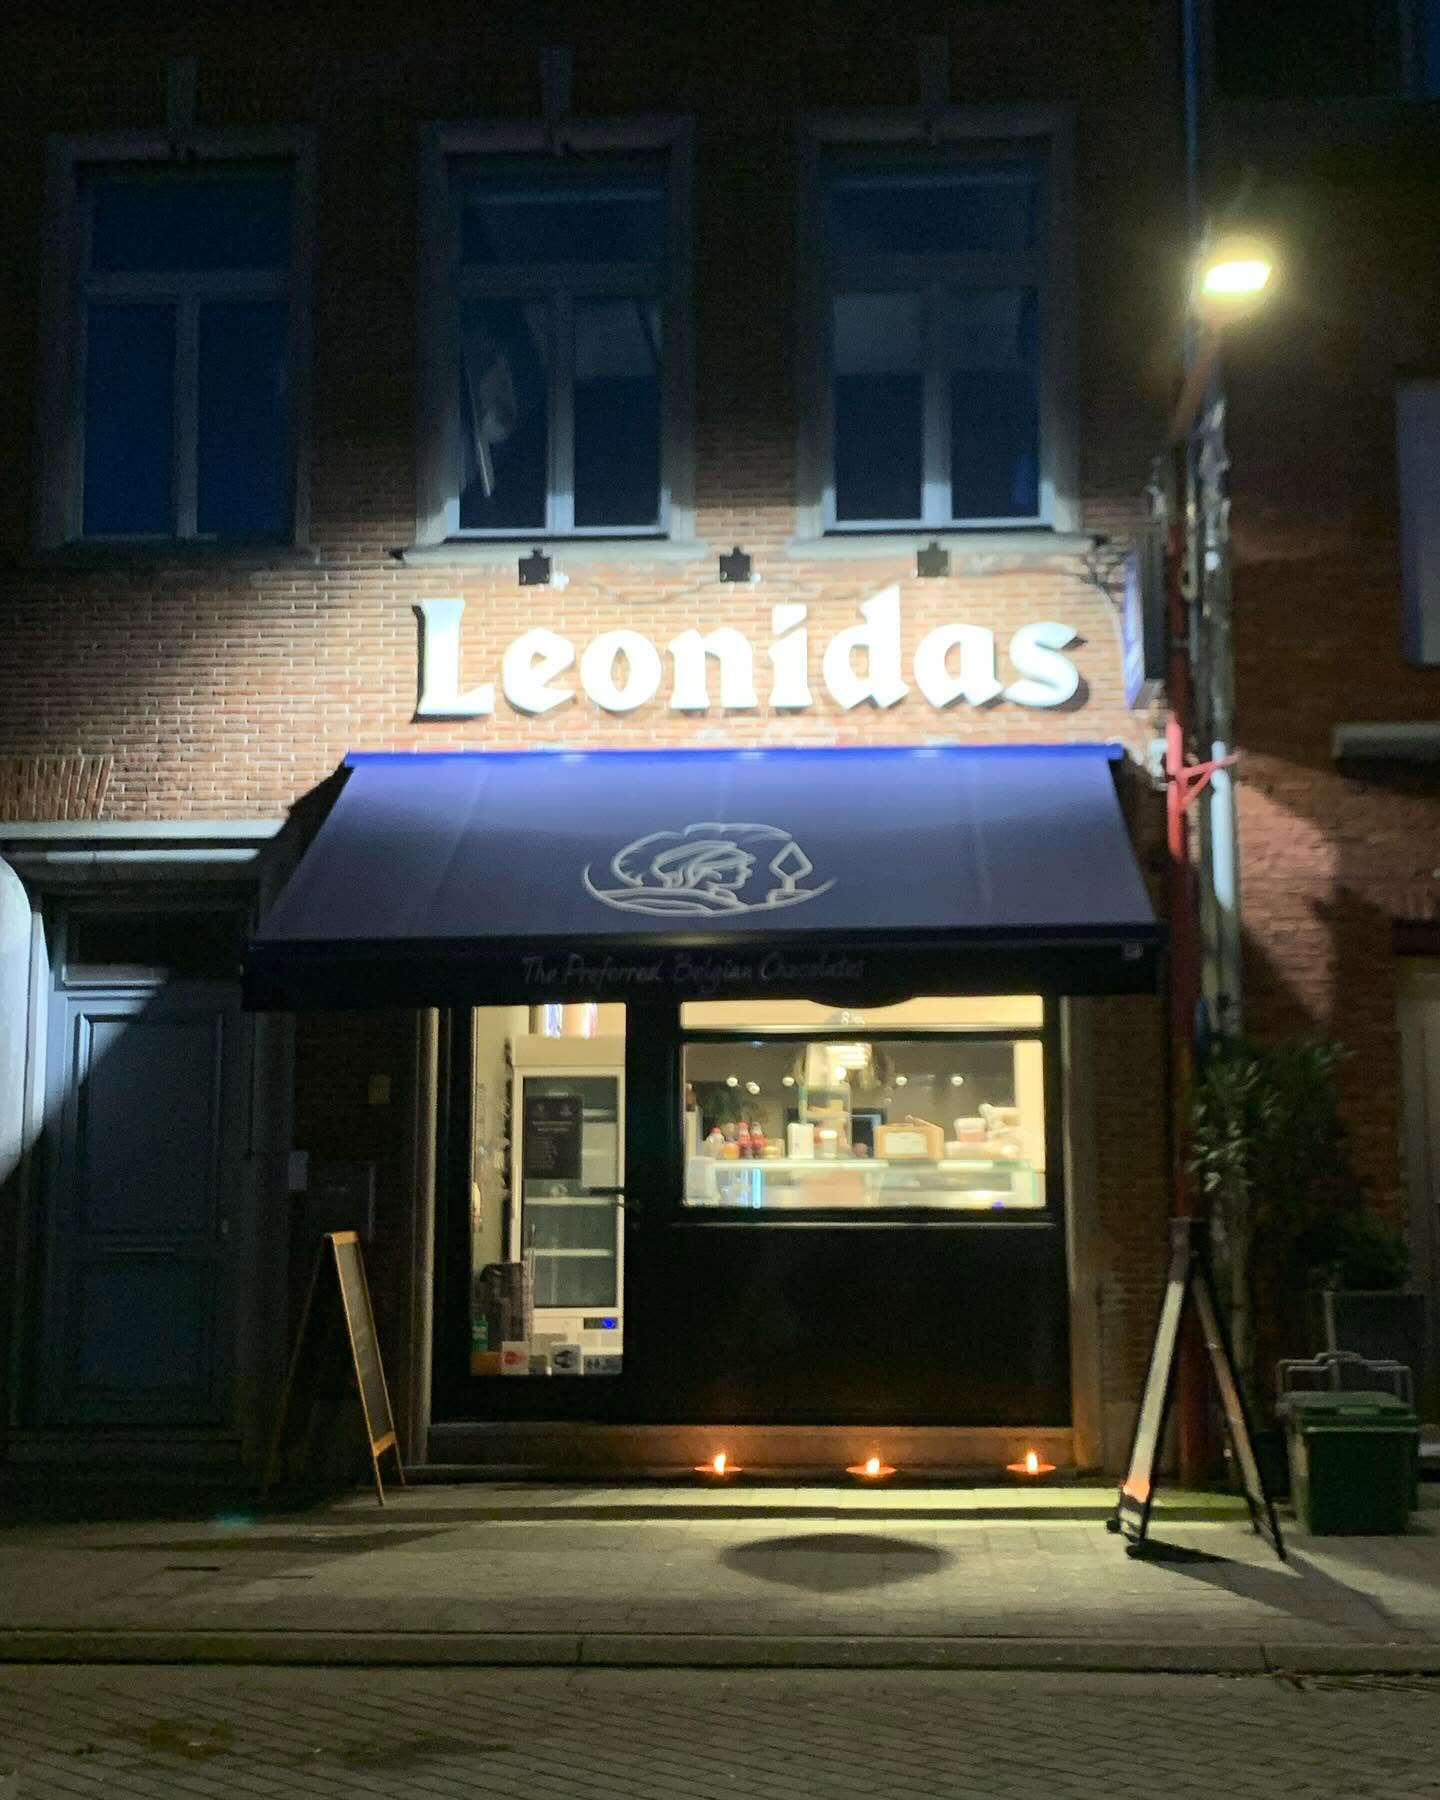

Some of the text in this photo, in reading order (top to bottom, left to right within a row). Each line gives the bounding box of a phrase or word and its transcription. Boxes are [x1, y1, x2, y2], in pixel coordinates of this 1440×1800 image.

[414, 585, 1083, 719] Leonidas
[521, 955, 558, 985] The
[561, 952, 665, 992] Preferred
